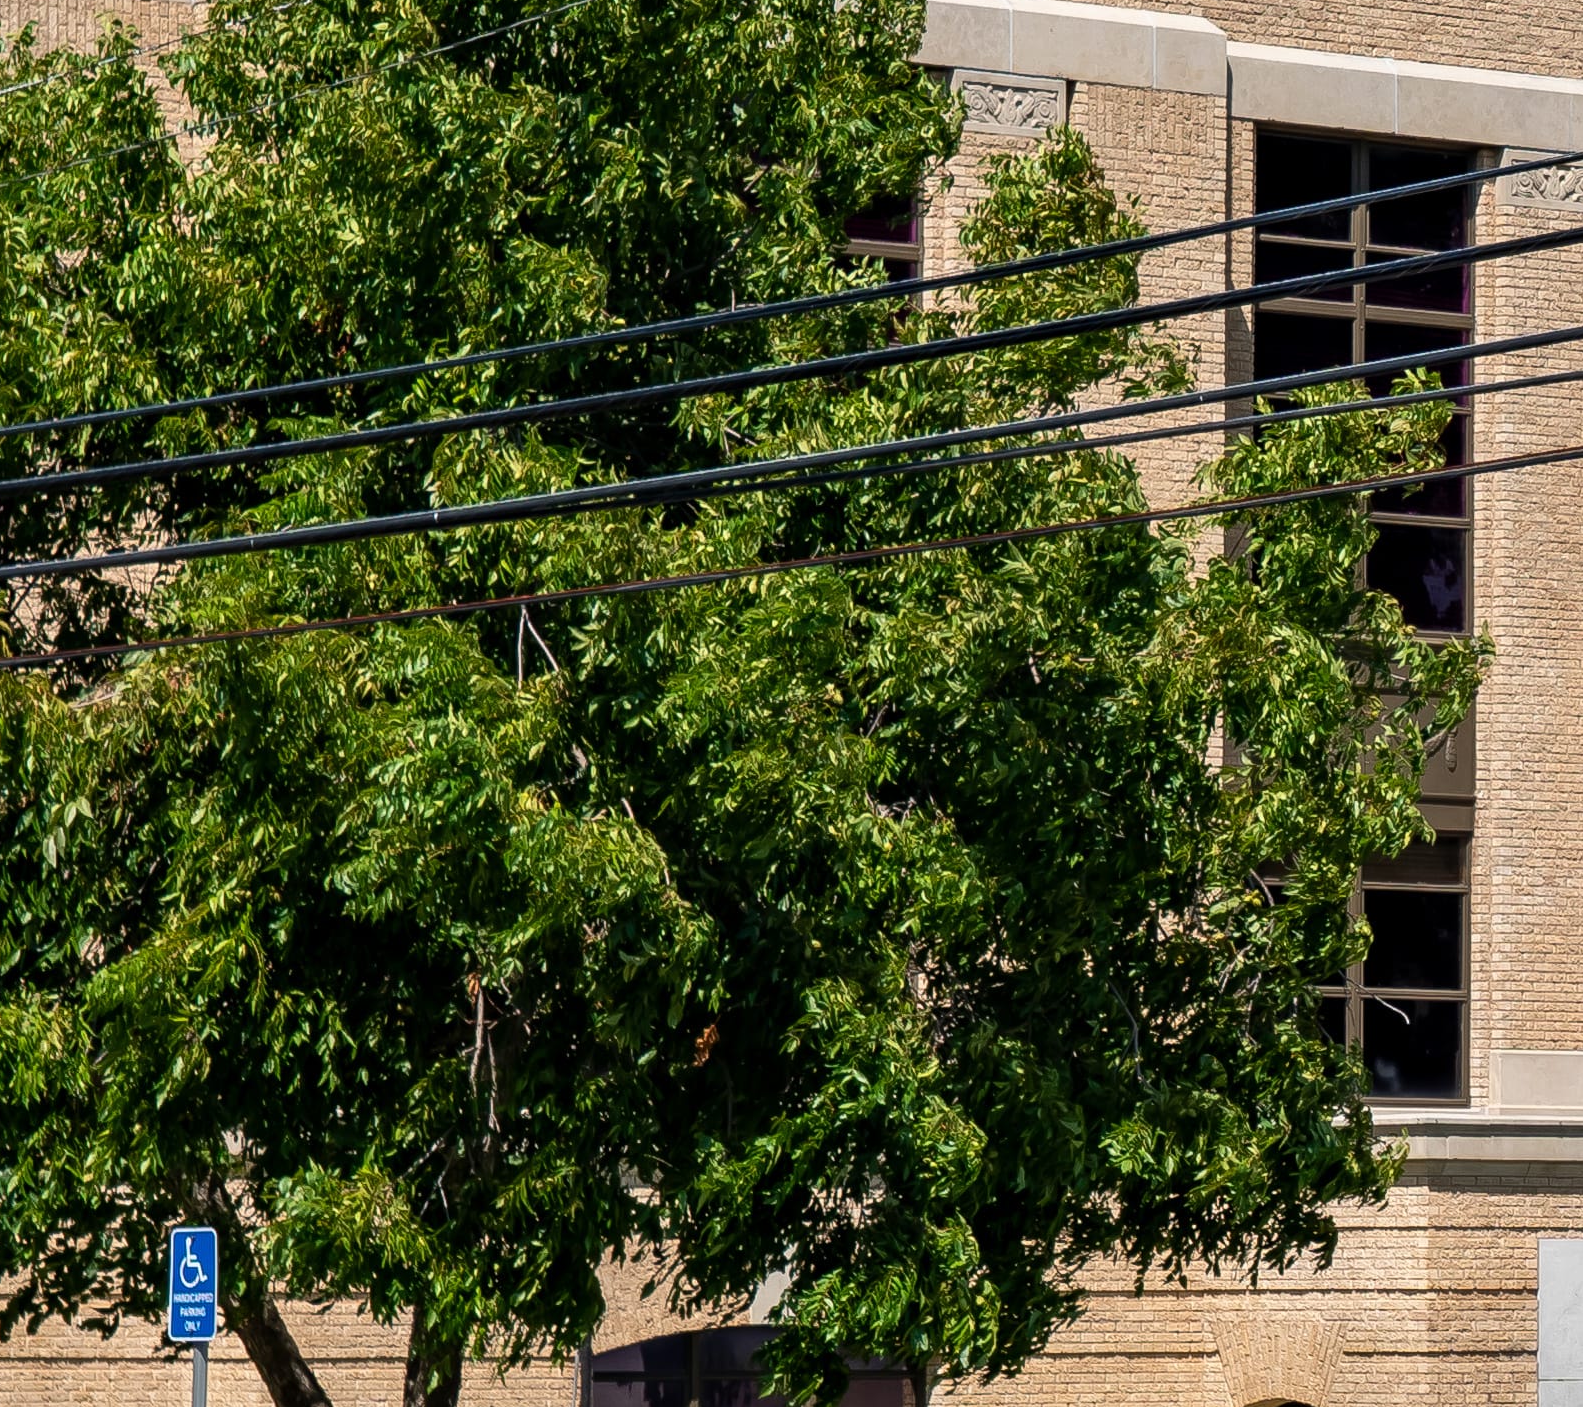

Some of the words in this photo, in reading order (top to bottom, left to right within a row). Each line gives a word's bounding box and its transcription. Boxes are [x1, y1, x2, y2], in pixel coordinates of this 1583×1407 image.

[173, 1292, 214, 1304] HANDICAPPED
[180, 1306, 206, 1318] PARKING
[184, 1320, 201, 1332] ONLY
